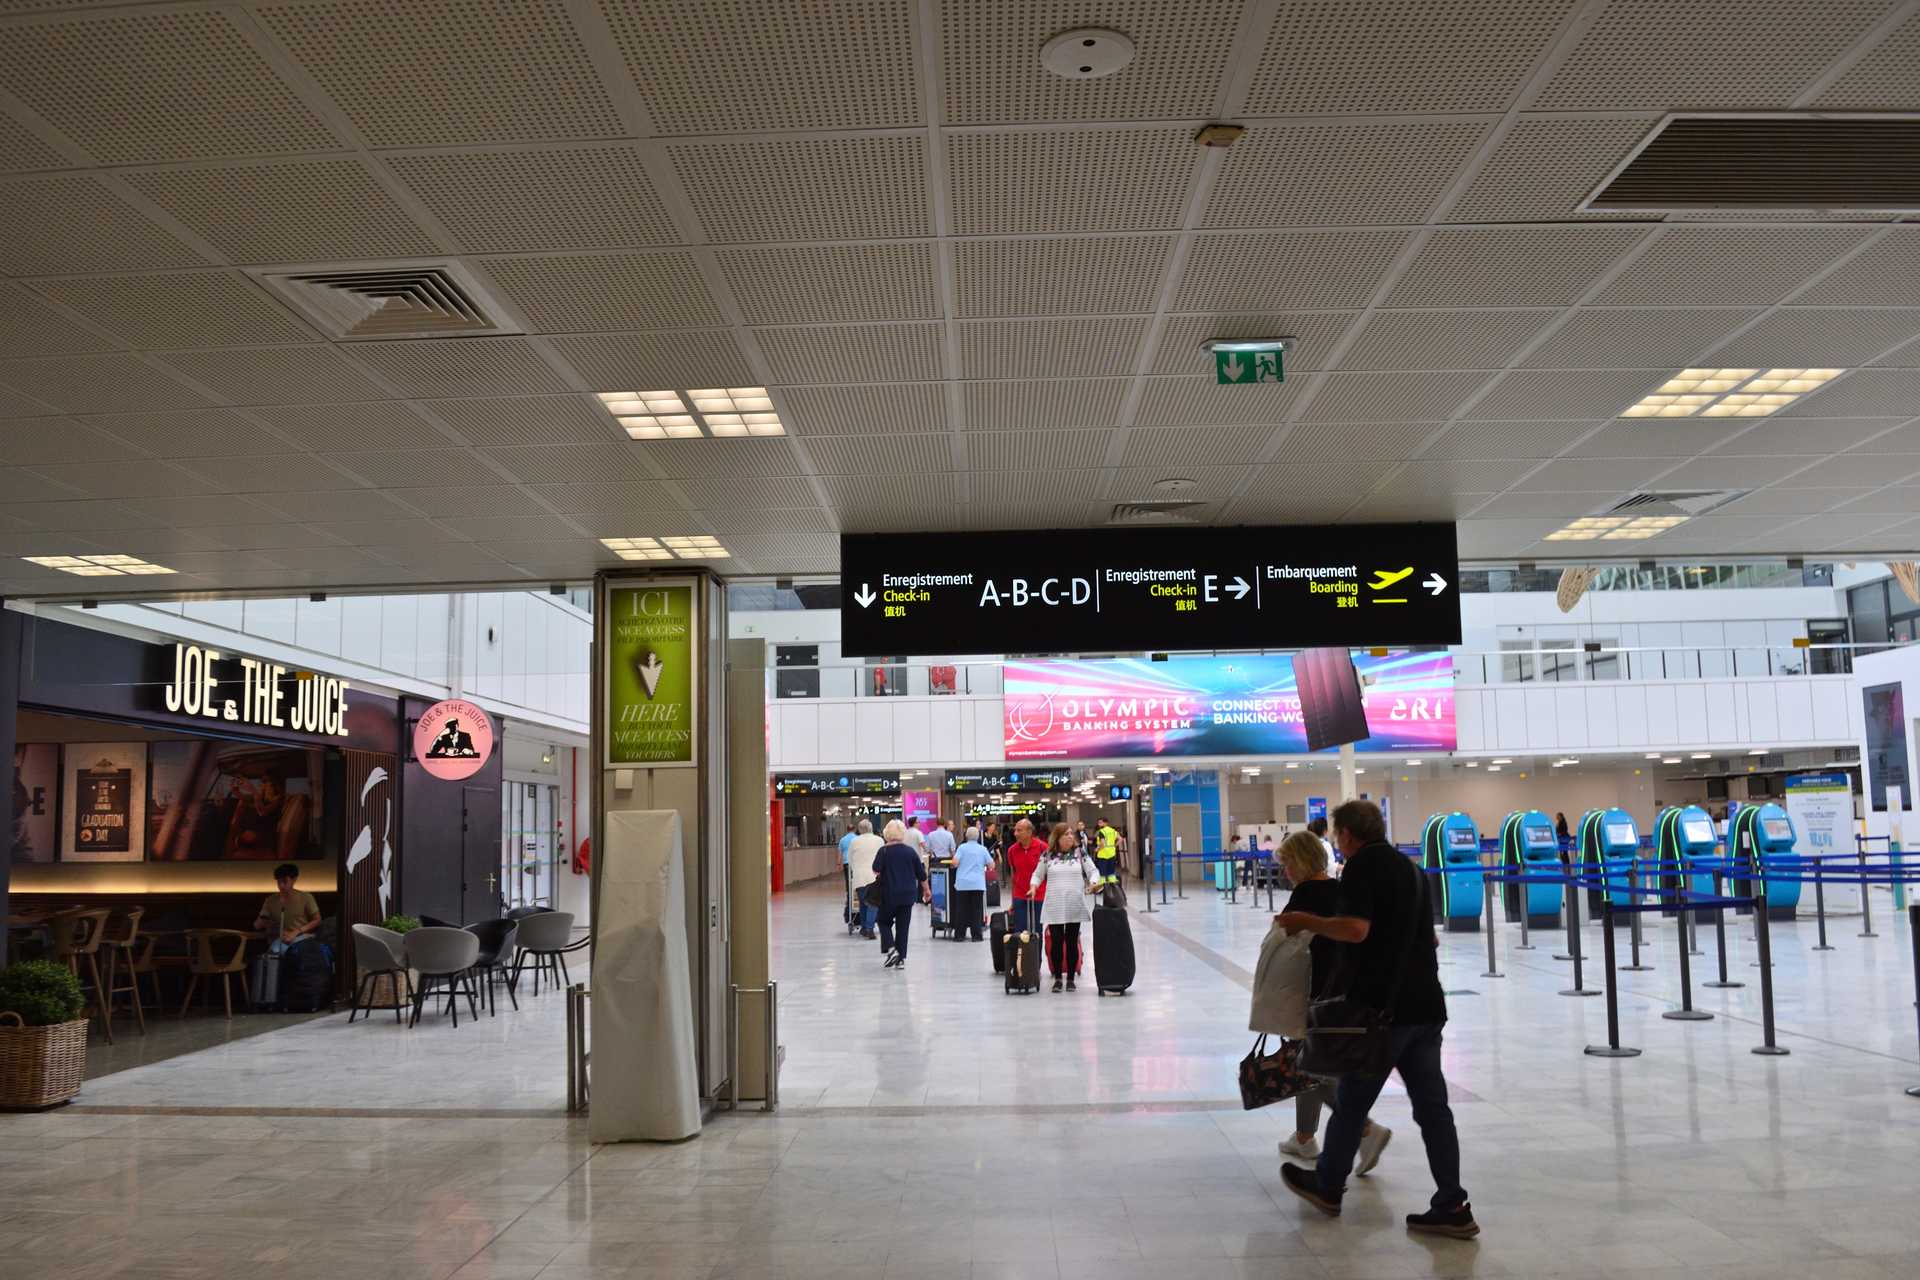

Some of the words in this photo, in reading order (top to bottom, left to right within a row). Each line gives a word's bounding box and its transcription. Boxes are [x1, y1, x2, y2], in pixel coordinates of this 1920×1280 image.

[1105, 568, 1196, 584] Enregistrement
[1266, 565, 1357, 581] Embarquement
[882, 573, 973, 589] Enregistrement
[1203, 574, 1219, 603] E
[1309, 581, 1359, 596] Boarding
[883, 589, 931, 602] Check-in
[979, 578, 1091, 607] A-B-C-D
[1149, 584, 1197, 597] Check-in
[631, 591, 671, 617] ICI
[1175, 600, 1198, 611] 值机
[1336, 597, 1359, 608] 登机
[884, 606, 907, 617] 值机
[165, 643, 221, 718] JOE
[223, 699, 239, 721] &
[240, 658, 286, 727] THE
[291, 674, 350, 737] JUICE
[620, 704, 682, 722] HERE
[1062, 699, 1190, 718] OLYMPIC
[1213, 700, 1281, 712] CONNECT
[1284, 699, 1300, 710] TO
[420, 713, 435, 732] JOE
[440, 703, 464, 714] THE
[464, 708, 488, 732] JUICE
[1063, 721, 1129, 731] BANKING
[1135, 719, 1190, 729] SYSTEM
[1213, 712, 1278, 724] BANKING
[883, 780, 890, 789] D
